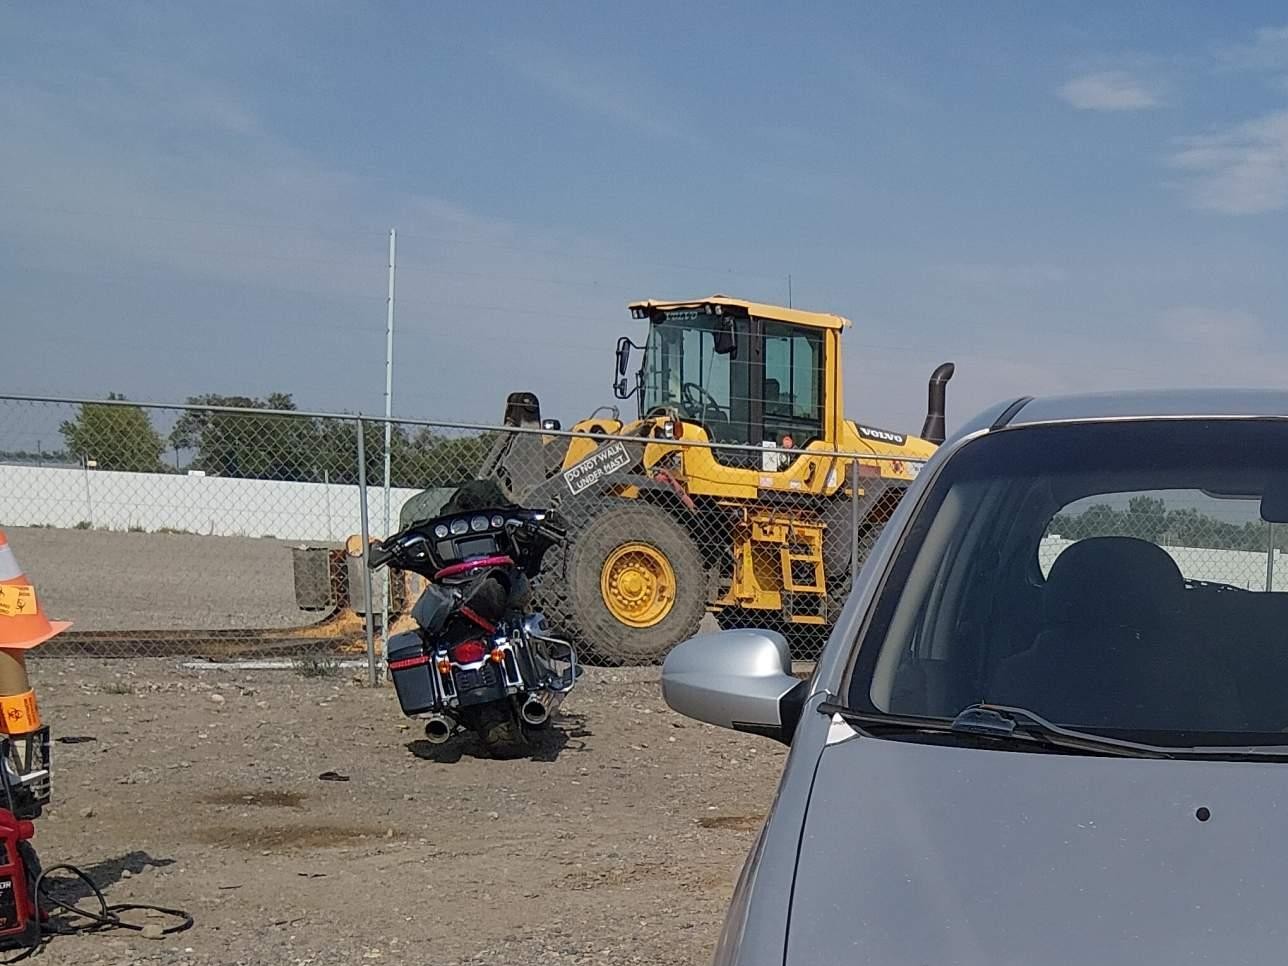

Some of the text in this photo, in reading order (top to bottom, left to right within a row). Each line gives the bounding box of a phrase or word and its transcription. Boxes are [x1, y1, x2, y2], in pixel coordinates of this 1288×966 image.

[859, 427, 903, 443] VOLVO
[567, 443, 623, 482] DO NOT WALK
[576, 455, 624, 488] UNDER MAST
